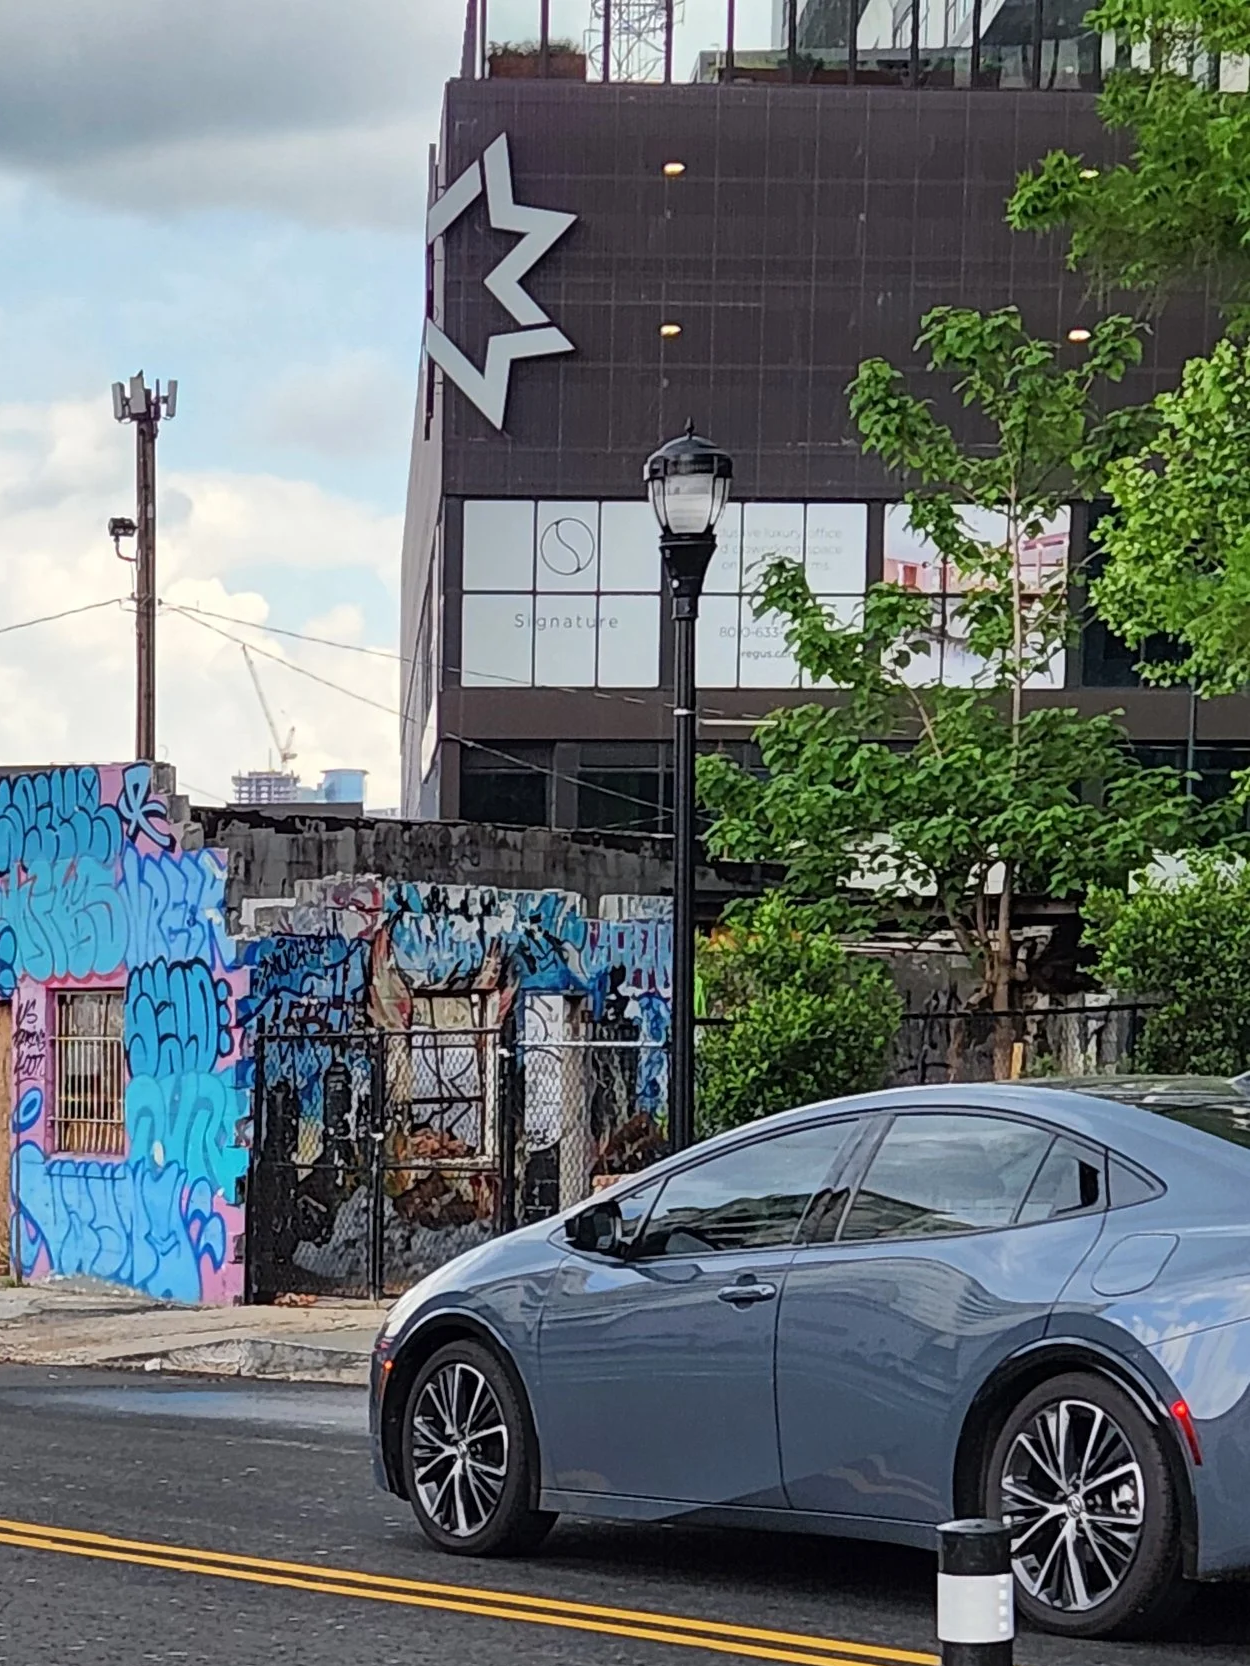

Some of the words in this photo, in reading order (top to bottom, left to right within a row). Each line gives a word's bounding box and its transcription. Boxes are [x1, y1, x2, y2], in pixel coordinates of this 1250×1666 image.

[514, 613, 619, 631] Signature
[719, 626, 784, 638] 800-633-
[741, 650, 791, 661] regus.c
